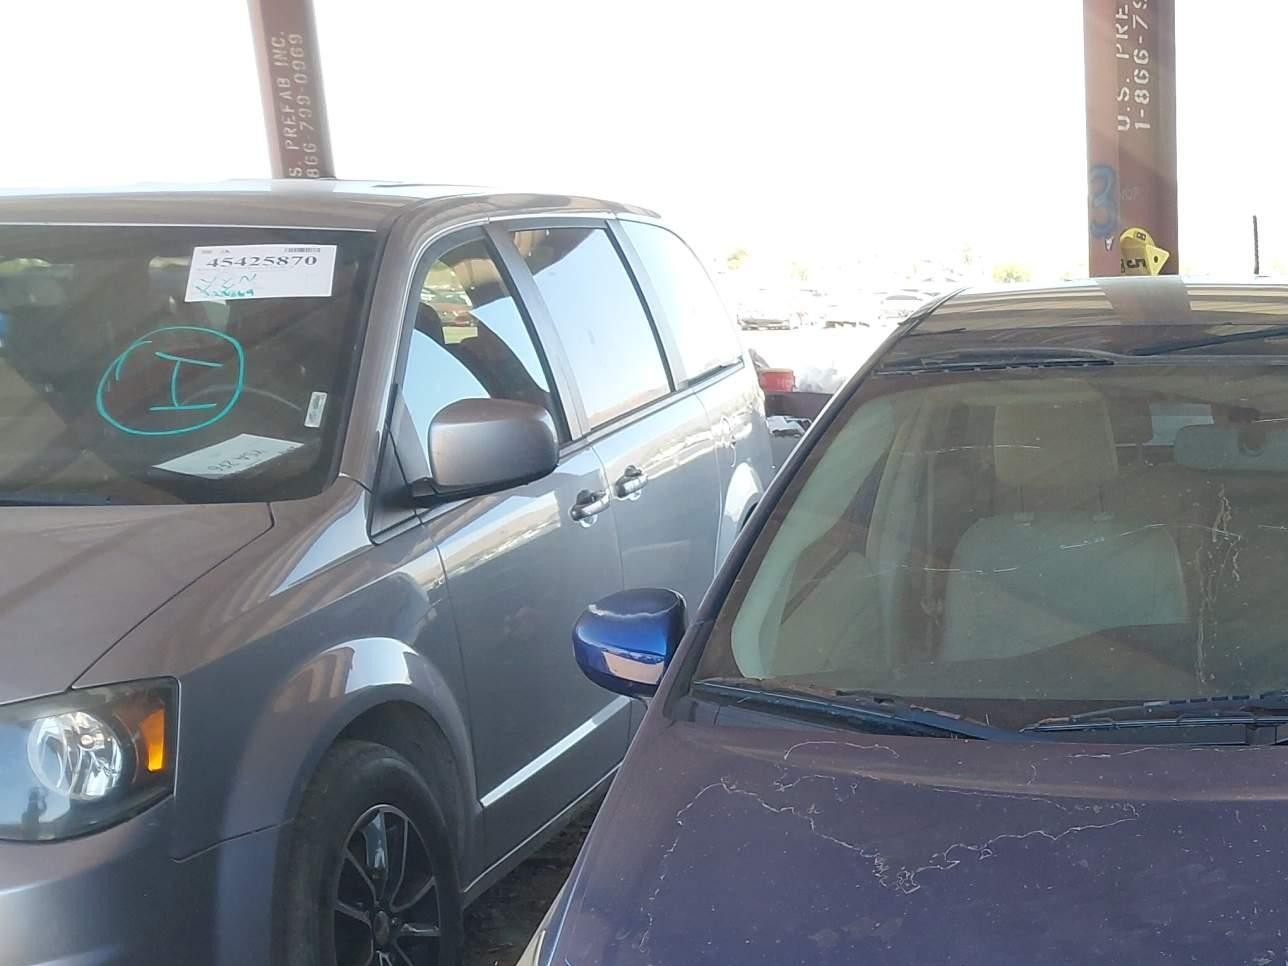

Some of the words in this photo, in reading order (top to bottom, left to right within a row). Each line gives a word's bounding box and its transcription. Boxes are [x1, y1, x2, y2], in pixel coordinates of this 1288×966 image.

[271, 31, 289, 66] INC.
[276, 77, 300, 151] PREFAB
[1116, 77, 1131, 131] U.S.
[205, 255, 318, 268] 45425870
